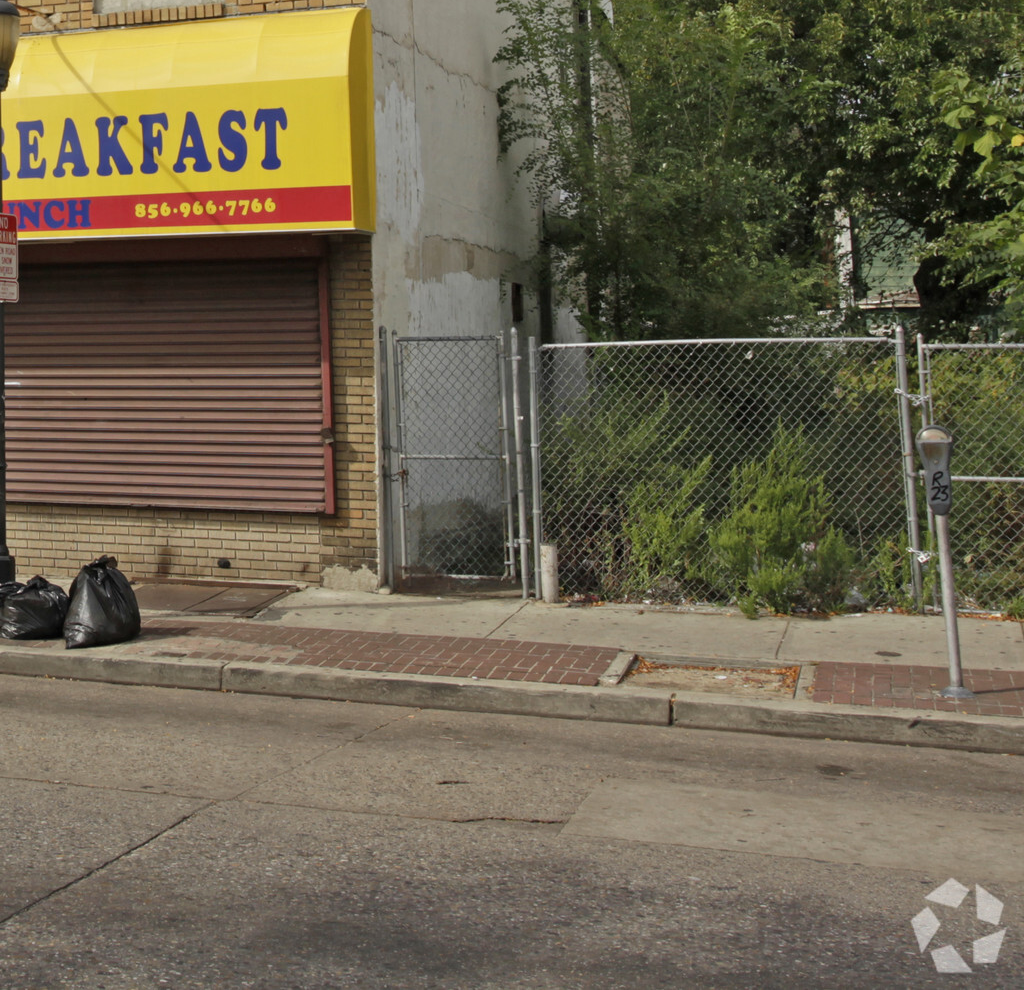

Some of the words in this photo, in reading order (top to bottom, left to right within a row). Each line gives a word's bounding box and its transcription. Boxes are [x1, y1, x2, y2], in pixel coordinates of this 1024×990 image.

[0, 217, 9, 229] NO
[2, 256, 12, 264] SNOW
[932, 471, 944, 487] R
[931, 485, 949, 502] 23
